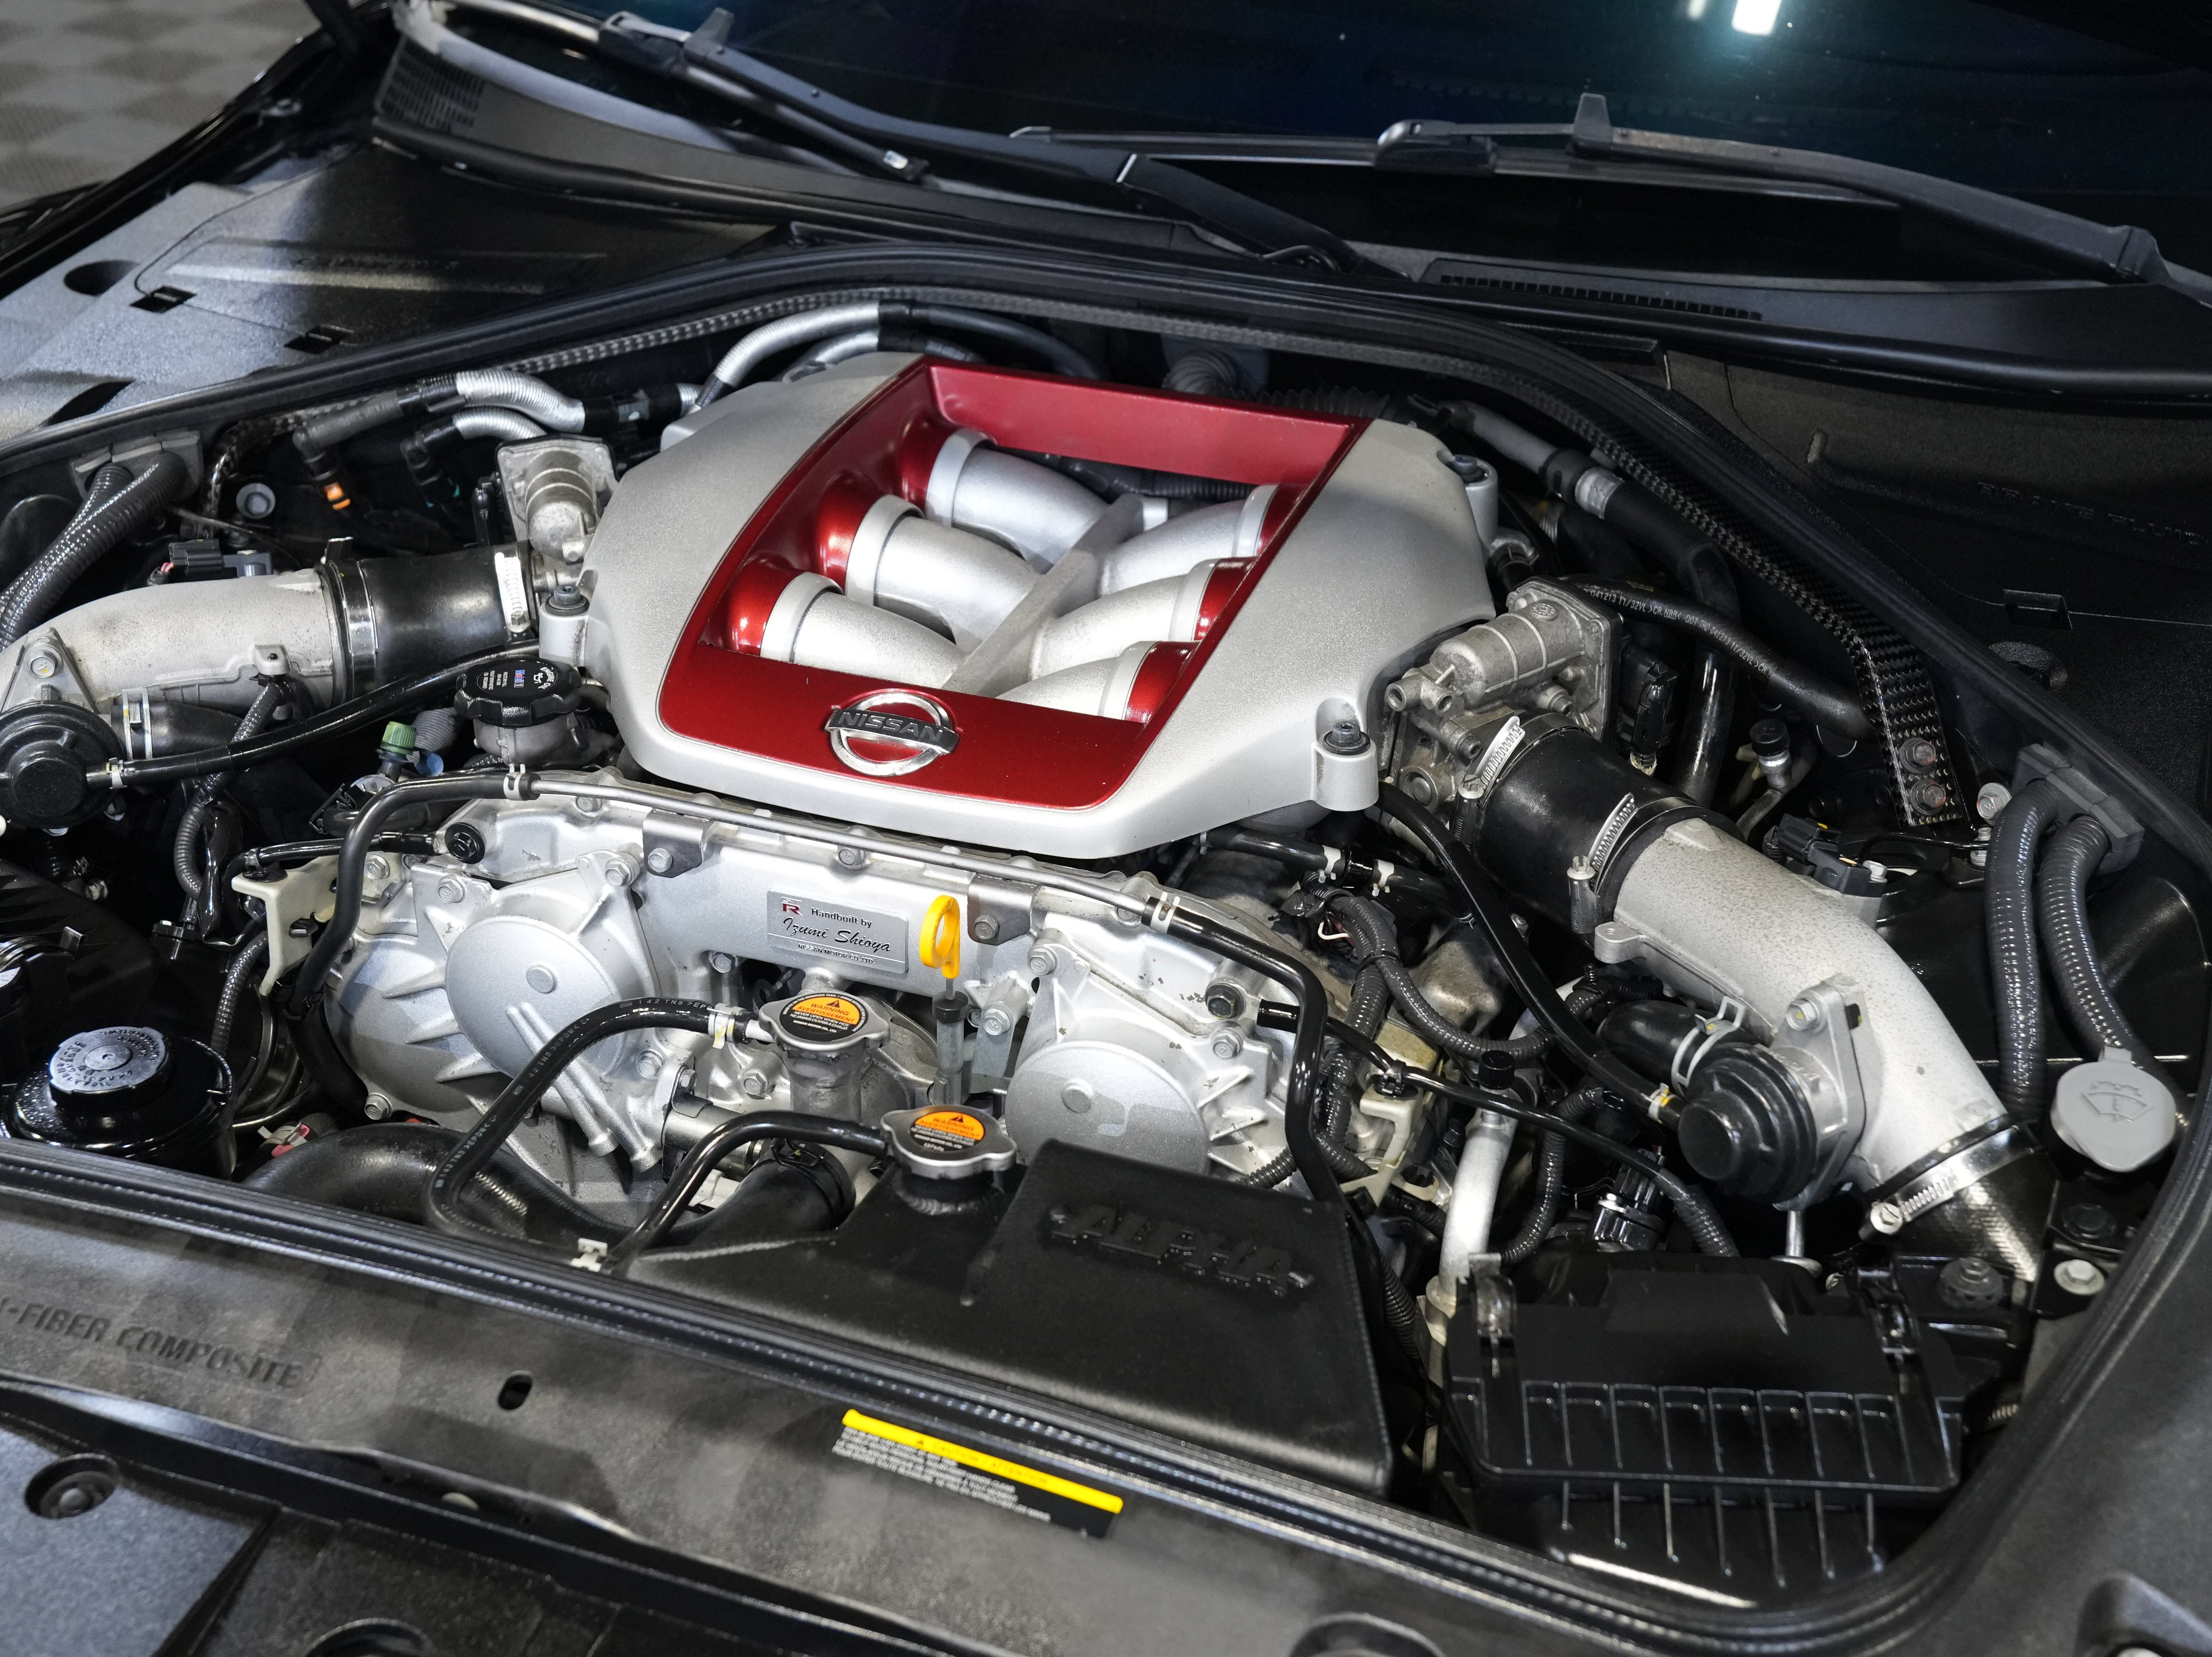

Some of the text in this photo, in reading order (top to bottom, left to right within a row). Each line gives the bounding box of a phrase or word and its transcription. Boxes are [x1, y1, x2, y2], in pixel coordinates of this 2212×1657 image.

[540, 667, 555, 683] ENGINE
[837, 712, 943, 742] NISSAN
[811, 907, 873, 928] Handbuilt by
[783, 916, 892, 953] Izumi Shioya
[798, 943, 823, 953] NISSAN
[824, 948, 848, 958] MOTOR
[797, 1006, 856, 1022] AVERTISSEMENT
[811, 1003, 849, 1016] WARNING
[0, 1297, 305, 1389] -FIBER COMPOSITE
